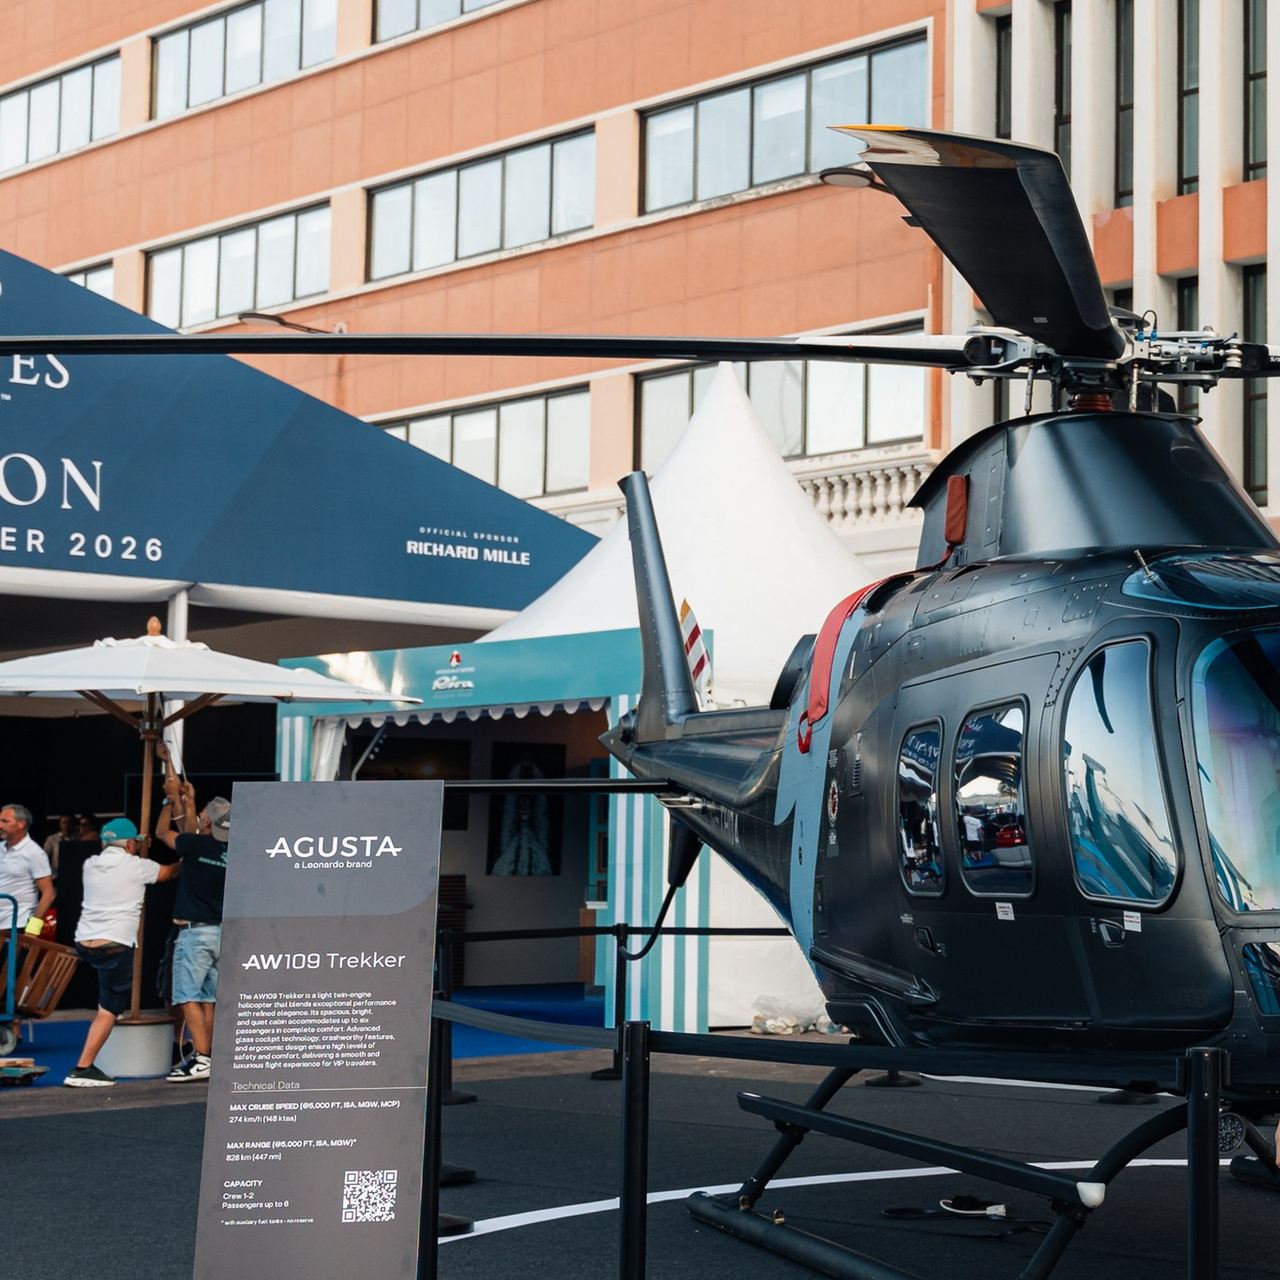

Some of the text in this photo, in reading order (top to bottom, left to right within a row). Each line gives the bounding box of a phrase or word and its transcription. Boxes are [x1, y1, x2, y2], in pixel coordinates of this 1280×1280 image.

[0, 452, 103, 512] ON
[419, 526, 519, 544] OFFICIAL SPONSOR
[0, 526, 163, 562] ER 2026
[406, 540, 530, 566] RICHARD MILLE
[432, 675, 474, 691] Riva
[265, 836, 403, 858] AGUSTA
[302, 861, 344, 869] Leonardo
[346, 860, 373, 868] brand
[242, 952, 406, 970] AW109 Trekker
[317, 992, 332, 1000] light
[238, 1002, 272, 1010] helicopter
[312, 1000, 352, 1008] exceptional
[353, 999, 397, 1007] performance
[276, 1009, 310, 1018] elegance.
[250, 1019, 268, 1027] quiet
[235, 1028, 275, 1036] passengers
[282, 1027, 315, 1035] complete
[255, 1036, 280, 1044] cockpit
[248, 1045, 284, 1053] ergonomic
[285, 1044, 307, 1052] design
[234, 1053, 257, 1061] safety
[301, 1052, 334, 1060] delivering
[264, 1061, 282, 1070] flight
[282, 1061, 321, 1069] experience
[345, 1059, 377, 1067] travelers.
[232, 1081, 300, 1090] Technical Data
[380, 1100, 400, 1109] MCP)
[229, 1116, 243, 1124] 274
[243, 1115, 262, 1123] km/h
[262, 1115, 278, 1123] (148
[245, 1141, 271, 1149] RANGE
[240, 1153, 252, 1161] km
[252, 1153, 268, 1161] (447
[268, 1152, 282, 1161] nm)
[224, 1179, 263, 1188] CAPACITY
[222, 1201, 264, 1210] Passengers
[264, 1201, 274, 1209] up
